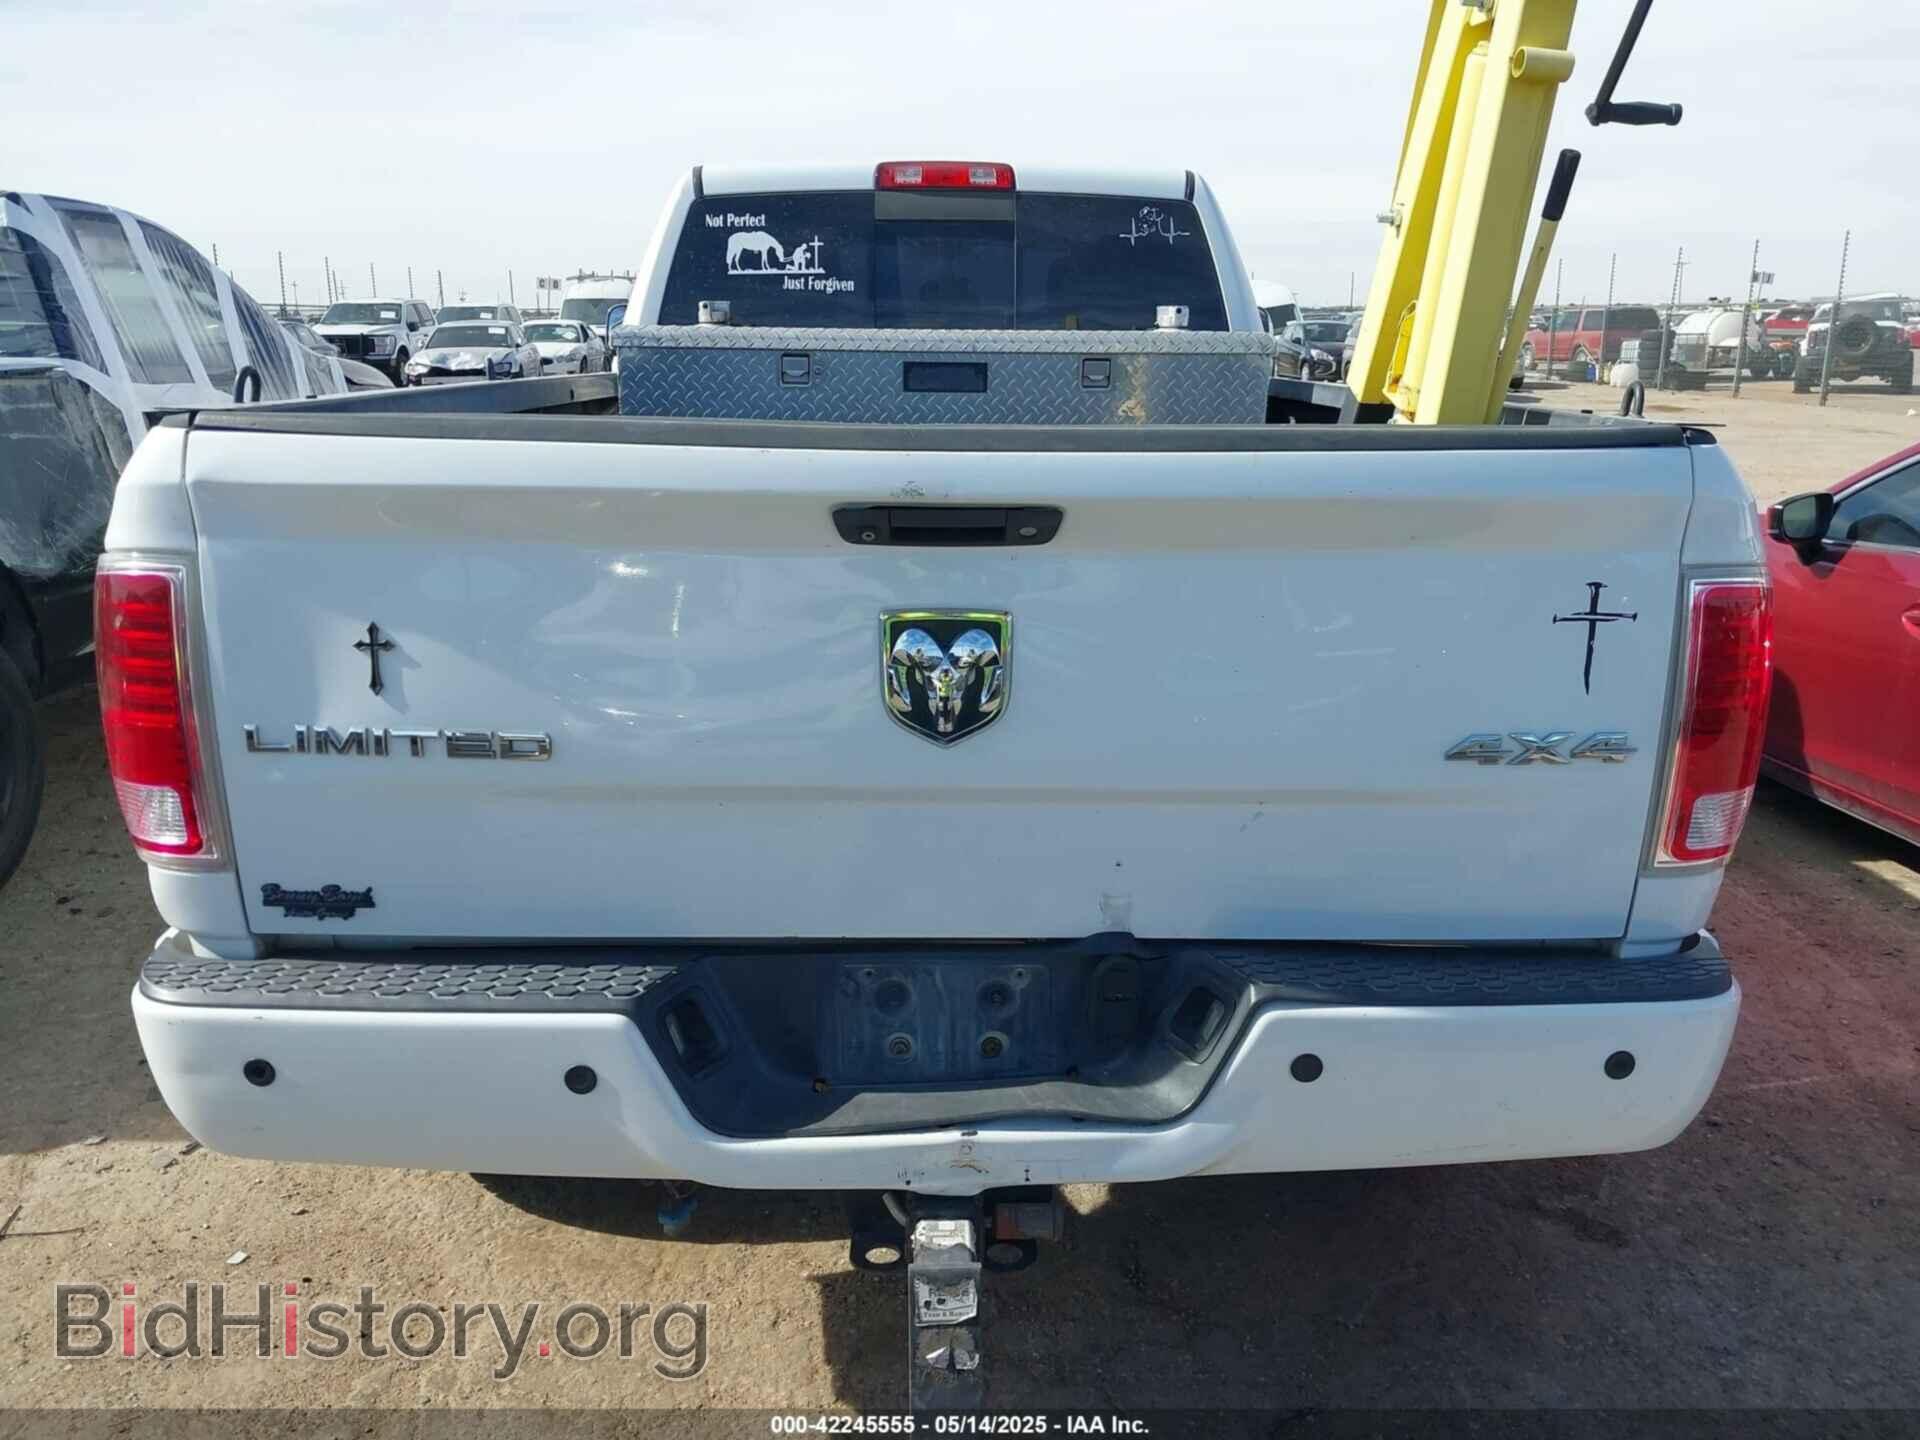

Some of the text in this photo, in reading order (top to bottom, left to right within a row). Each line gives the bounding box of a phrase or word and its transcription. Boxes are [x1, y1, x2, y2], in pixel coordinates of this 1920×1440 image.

[705, 212, 766, 227] Not Perfect
[782, 275, 855, 294] Just Forgiven
[243, 723, 554, 761] LIMITED
